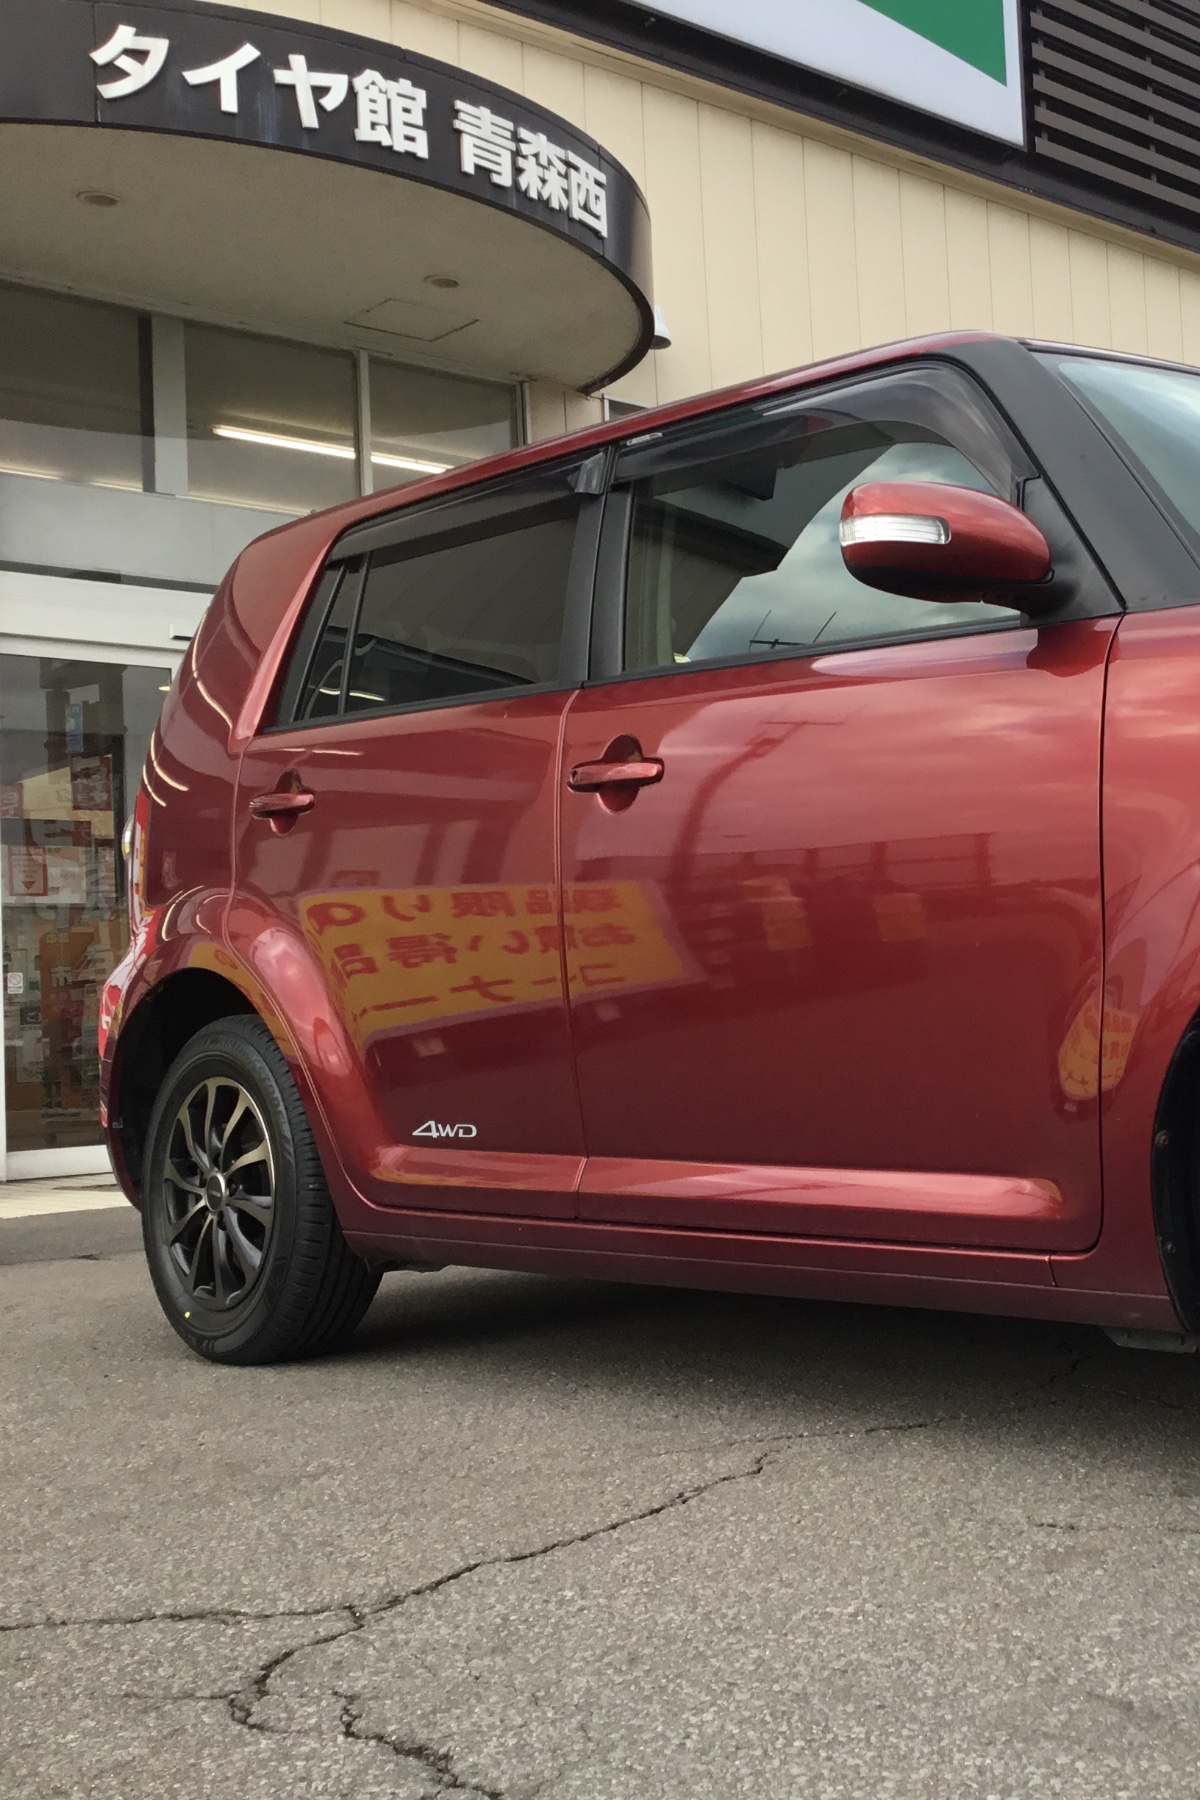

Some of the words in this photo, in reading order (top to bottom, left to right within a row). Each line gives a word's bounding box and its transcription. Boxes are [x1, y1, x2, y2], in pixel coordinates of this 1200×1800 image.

[89, 23, 428, 160] タイヤ館
[453, 98, 608, 239] 青森西
[412, 1120, 477, 1138] 4WD
